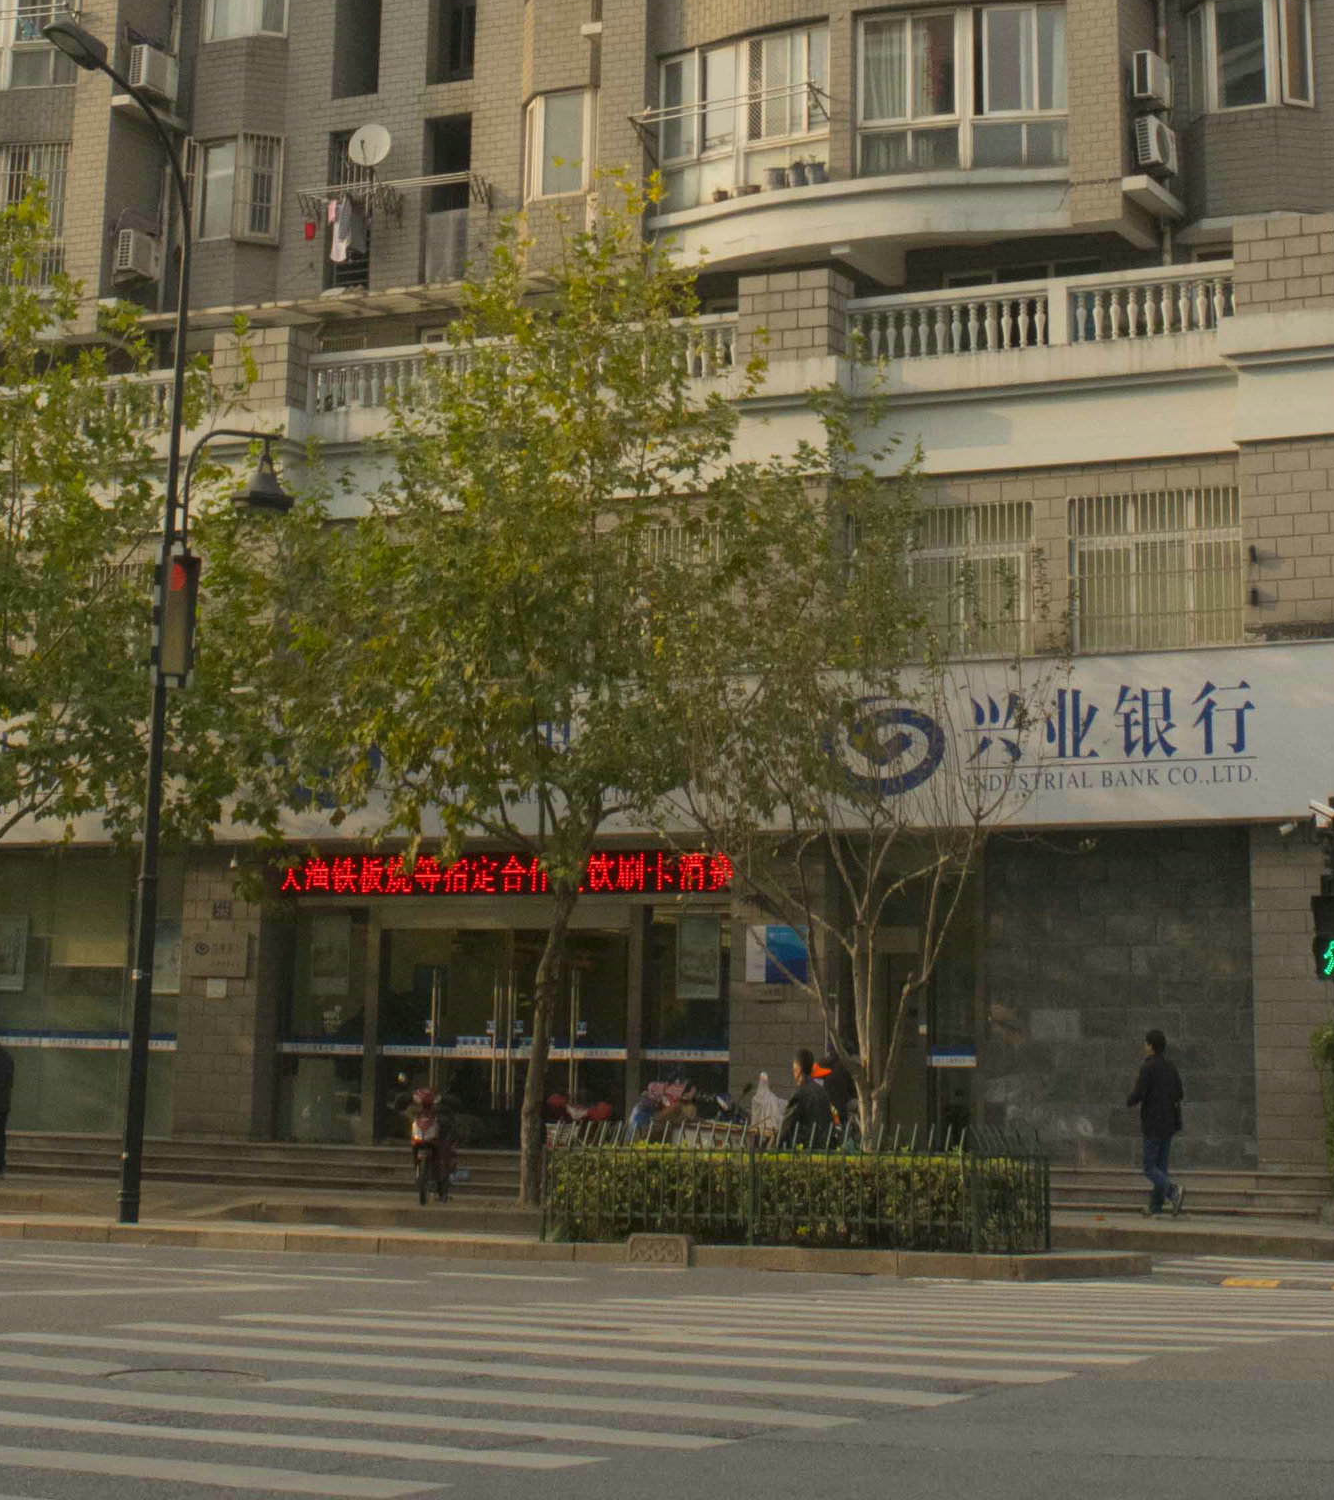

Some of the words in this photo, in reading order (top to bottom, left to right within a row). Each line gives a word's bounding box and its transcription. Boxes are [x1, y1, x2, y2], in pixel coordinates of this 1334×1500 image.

[963, 680, 1256, 763] 兴业银行
[966, 771, 1094, 792] INDUSTRIAL
[1101, 767, 1160, 788] BANK
